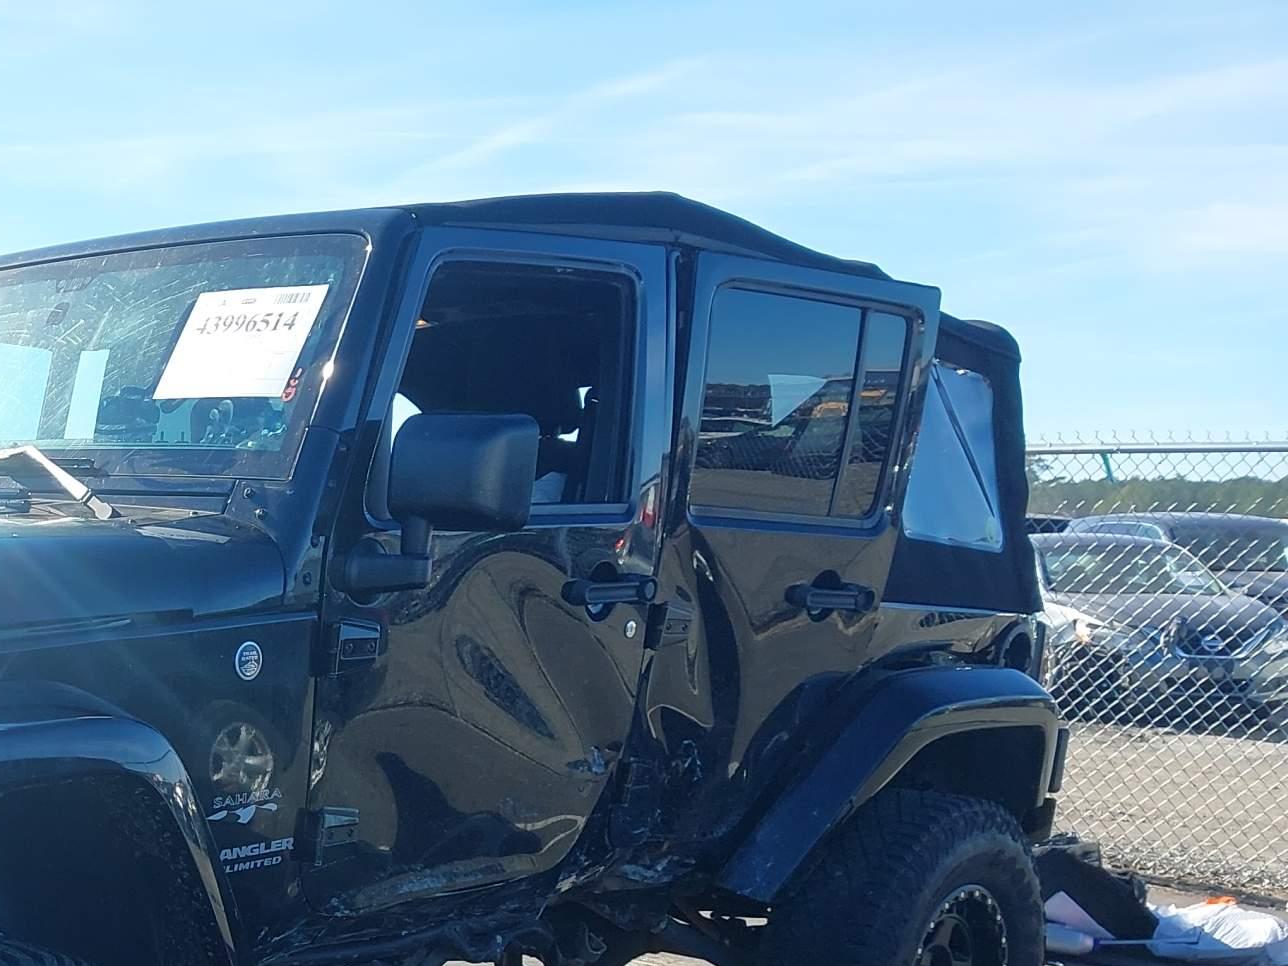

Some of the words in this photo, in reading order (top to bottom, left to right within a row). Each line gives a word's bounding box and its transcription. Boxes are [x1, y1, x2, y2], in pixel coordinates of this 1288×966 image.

[195, 311, 300, 335] 43996514
[212, 787, 282, 809] SAHARA
[219, 837, 294, 861] ANGLER
[223, 856, 282, 873] LIMITED
